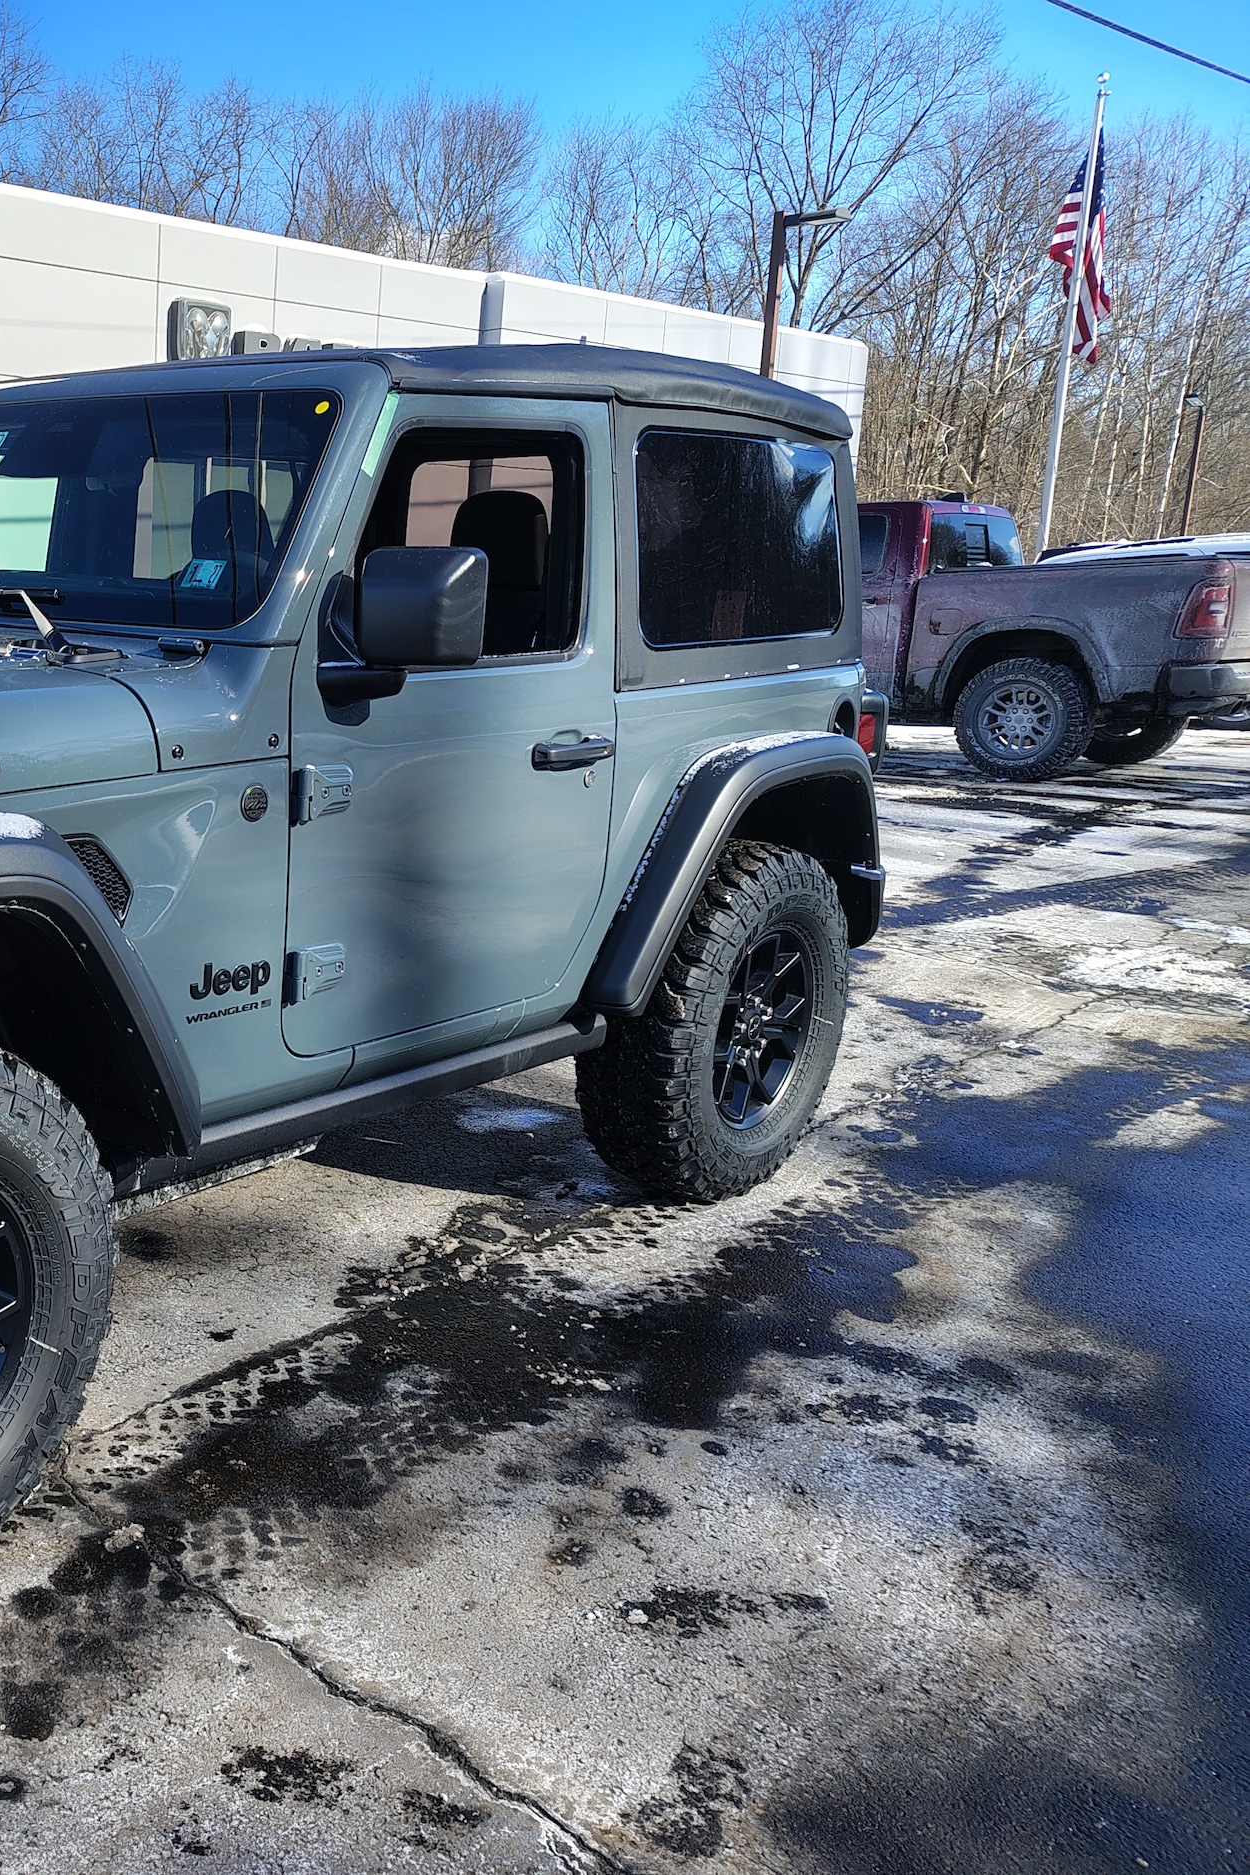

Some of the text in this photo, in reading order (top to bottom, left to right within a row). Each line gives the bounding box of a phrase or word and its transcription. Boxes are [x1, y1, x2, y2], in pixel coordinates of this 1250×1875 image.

[189, 960, 271, 1000] Jeep
[185, 1002, 259, 1024] WRANGLER
[12, 1162, 92, 1481] WILDPEAK
